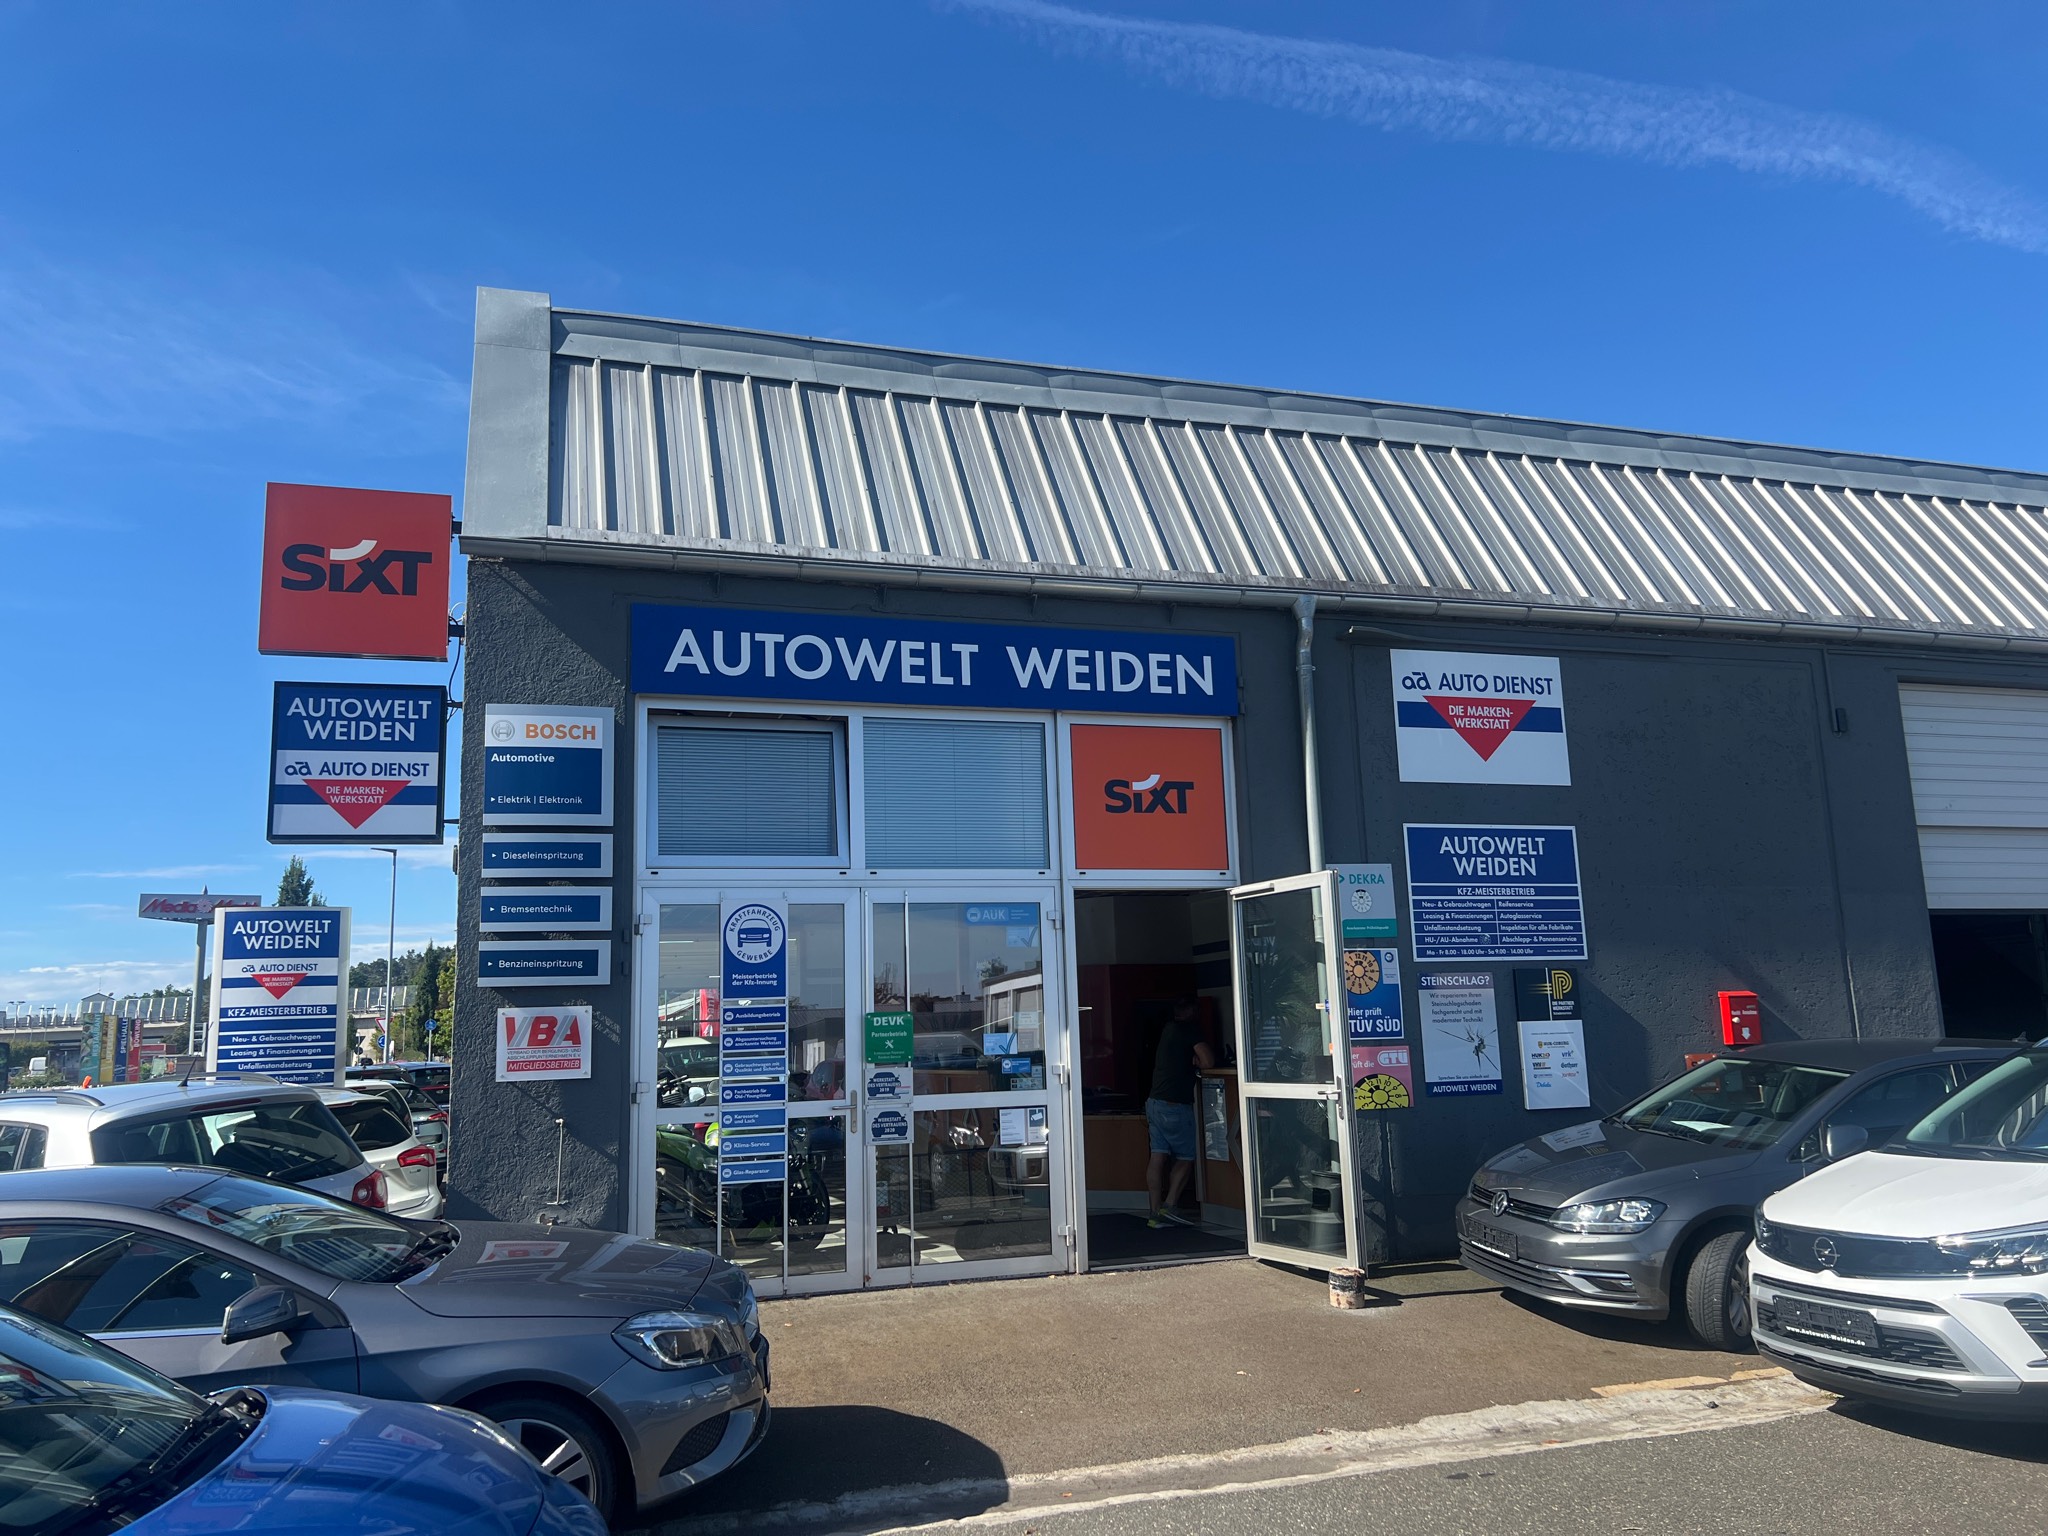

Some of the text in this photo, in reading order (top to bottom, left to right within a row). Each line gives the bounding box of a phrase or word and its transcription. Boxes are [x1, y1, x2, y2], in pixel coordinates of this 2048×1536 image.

[281, 539, 432, 596] SIXT
[663, 628, 1214, 697] AUTOWELT WEIDEN
[1438, 673, 1488, 692] AUTO
[1494, 676, 1553, 695] DIENST
[287, 697, 431, 720] AUTOWELT
[1448, 705, 1513, 718] DIE MARKEN-
[1454, 718, 1510, 730] WERKSTATT
[303, 720, 415, 742] WEIDEN
[525, 723, 597, 741] BOSCH
[491, 753, 556, 764] Automotive
[319, 762, 367, 777] AUTO
[371, 763, 430, 778] DIENST
[326, 785, 387, 796] DIE MARKEN-
[1104, 774, 1194, 815] SIXT
[330, 795, 383, 805] WERKSTATT
[497, 795, 583, 805] Elektrik Elektronik
[1439, 836, 1545, 855] AUTOWELT
[502, 850, 584, 862] Dieseleinspritzung
[1452, 857, 1536, 876] WEIDEN
[1349, 873, 1385, 885] DEKRA
[1457, 887, 1535, 896] KFZ-MEISTERBETRIEB
[142, 898, 198, 913] Media
[500, 903, 573, 914] Bremsentechnik
[1443, 901, 1491, 909] Gebrauchtwagen
[729, 908, 781, 932] KRAFTFAHRZEUG
[232, 920, 332, 935] AUTOWELT
[1423, 924, 1482, 932] Unfallinstandsetzung
[1500, 924, 1528, 932] Inspektion
[243, 935, 320, 950] WEIDEN
[1424, 936, 1478, 944] HU-/AU-Abnahme
[736, 949, 773, 962] GEWERBE
[259, 964, 285, 973] AUTO
[286, 963, 318, 972] DIENST
[498, 958, 583, 970] Benzineinspritzung
[1421, 975, 1490, 986] STEINSCHLAG?
[227, 1006, 328, 1017] KFZ-MEISTERBETRIEB
[1365, 1007, 1382, 1017] prüft
[873, 1016, 904, 1026] DEVK
[1349, 1016, 1401, 1033] TÜV SÜD
[120, 1017, 128, 1054] SPIELHALLE
[133, 1019, 141, 1048] BOWLING
[505, 1015, 581, 1047] VBA
[232, 1033, 321, 1043] Neu- & Gebrauchtwagen
[230, 1046, 321, 1057] Leasing & Finanzierungen
[238, 1061, 312, 1071] Unfallinstandsetzung
[508, 1060, 579, 1071] MITGLIEDSBETRIEB
[1433, 1083, 1497, 1093] AUTOWELT WEIDEN
[1785, 1325, 1865, 1347] www.Autowelt-Weiden.de
